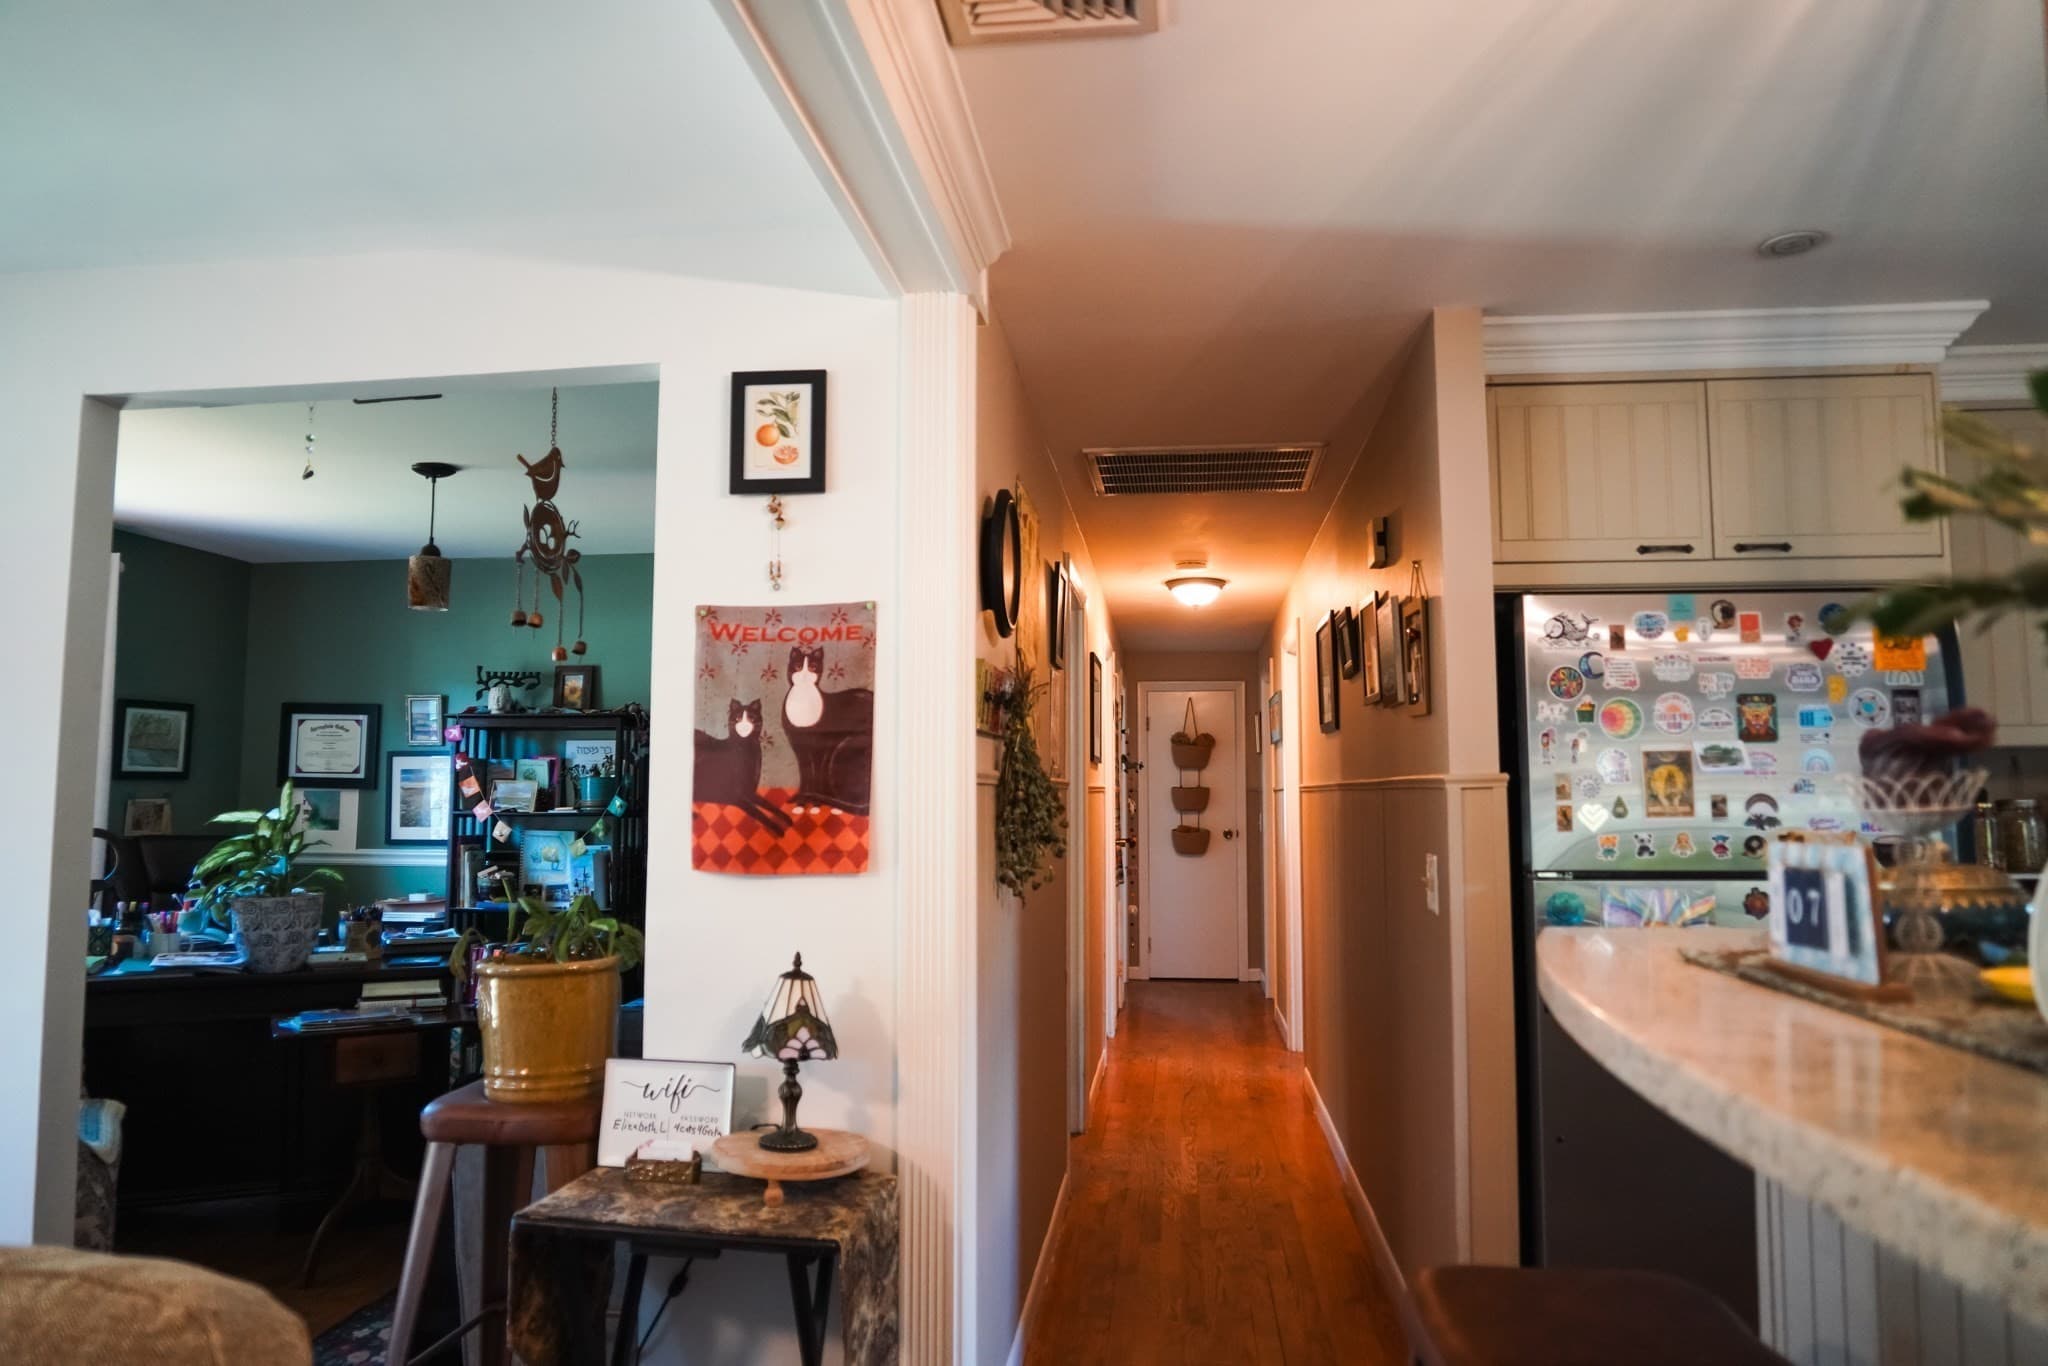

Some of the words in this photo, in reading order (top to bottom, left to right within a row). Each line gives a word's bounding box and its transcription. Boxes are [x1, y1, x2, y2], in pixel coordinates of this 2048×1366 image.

[707, 621, 864, 643] WELCOME
[1787, 887, 1821, 927] 07
[622, 1074, 720, 1114] wifi
